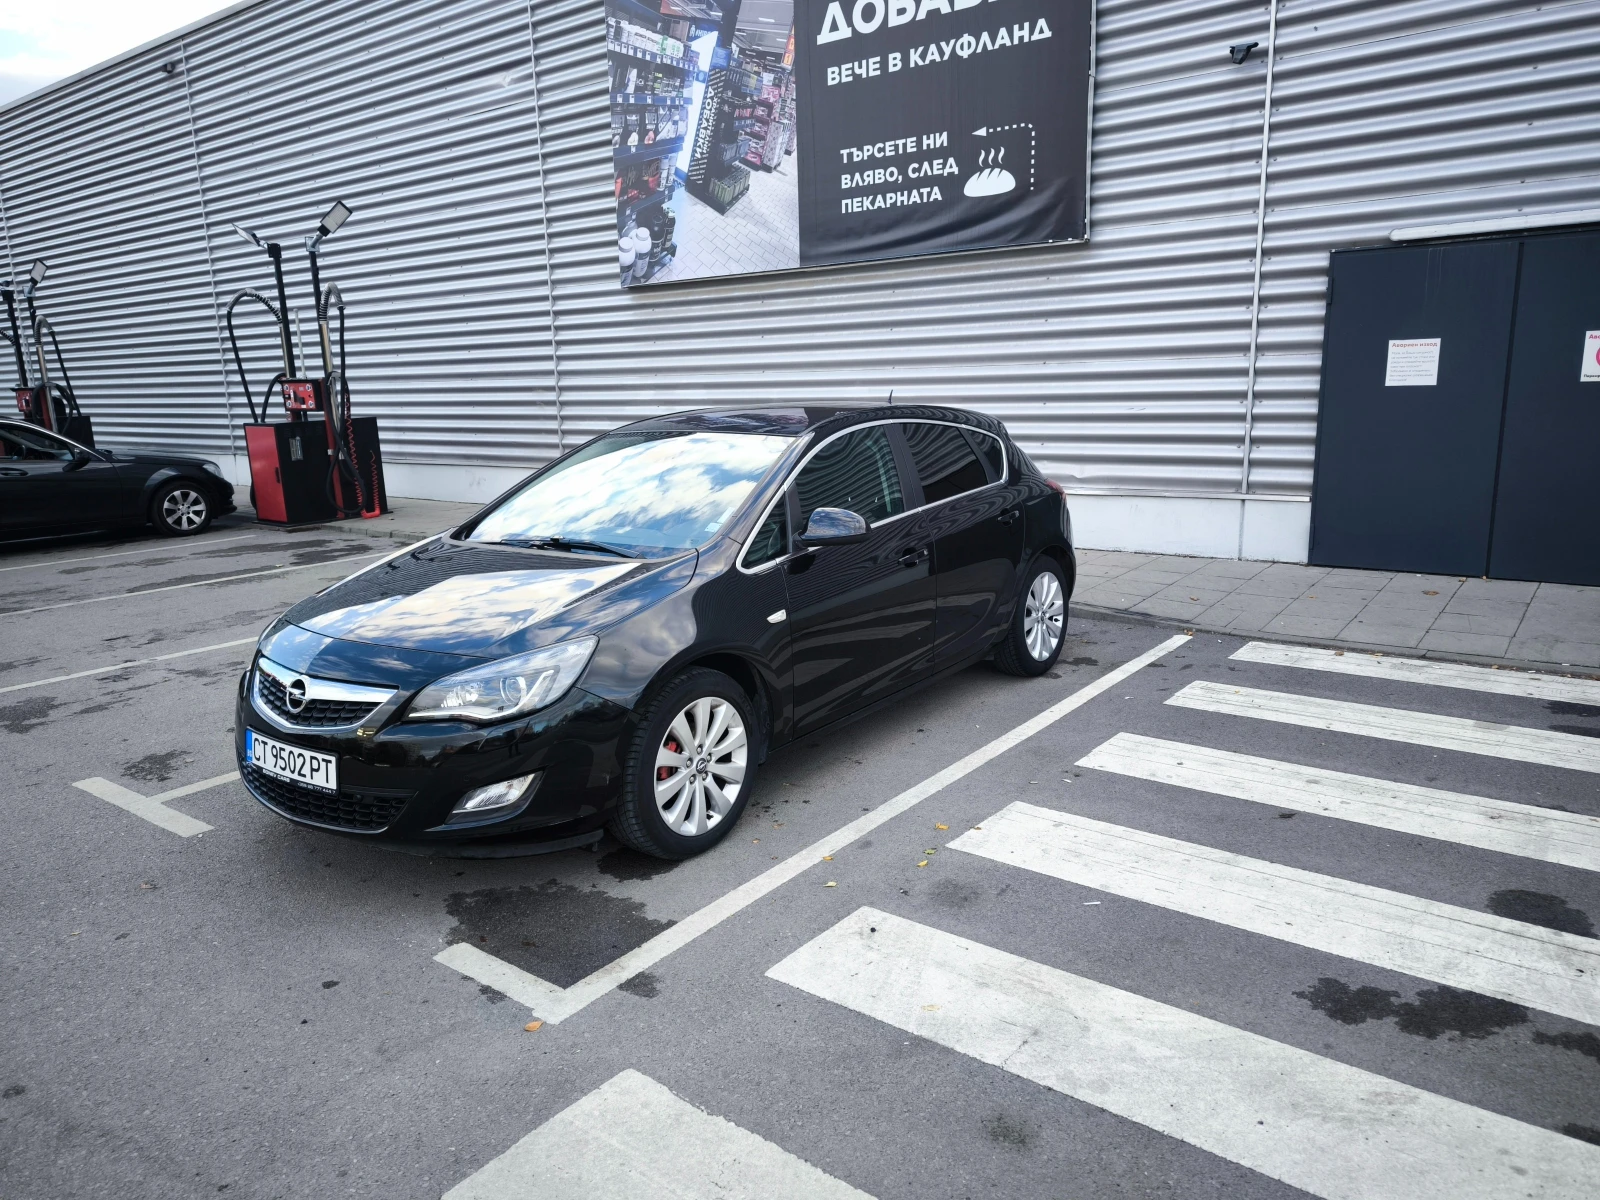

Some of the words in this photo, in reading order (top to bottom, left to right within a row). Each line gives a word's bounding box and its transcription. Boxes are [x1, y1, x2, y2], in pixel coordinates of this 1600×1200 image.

[827, 56, 881, 86] ВЕЧЕ
[888, 52, 902, 73] В
[909, 17, 1052, 68] КАУФЛАНД
[695, 86, 715, 159] ДОБАВКИ
[840, 136, 917, 164] ТЪРСЕТЕ
[922, 131, 948, 150] НИ
[841, 166, 903, 189] ВЛЯВО,
[908, 157, 959, 178] СЛЕД
[841, 186, 942, 214] ПЕКАРНАТА
[271, 745, 306, 778] 9502
